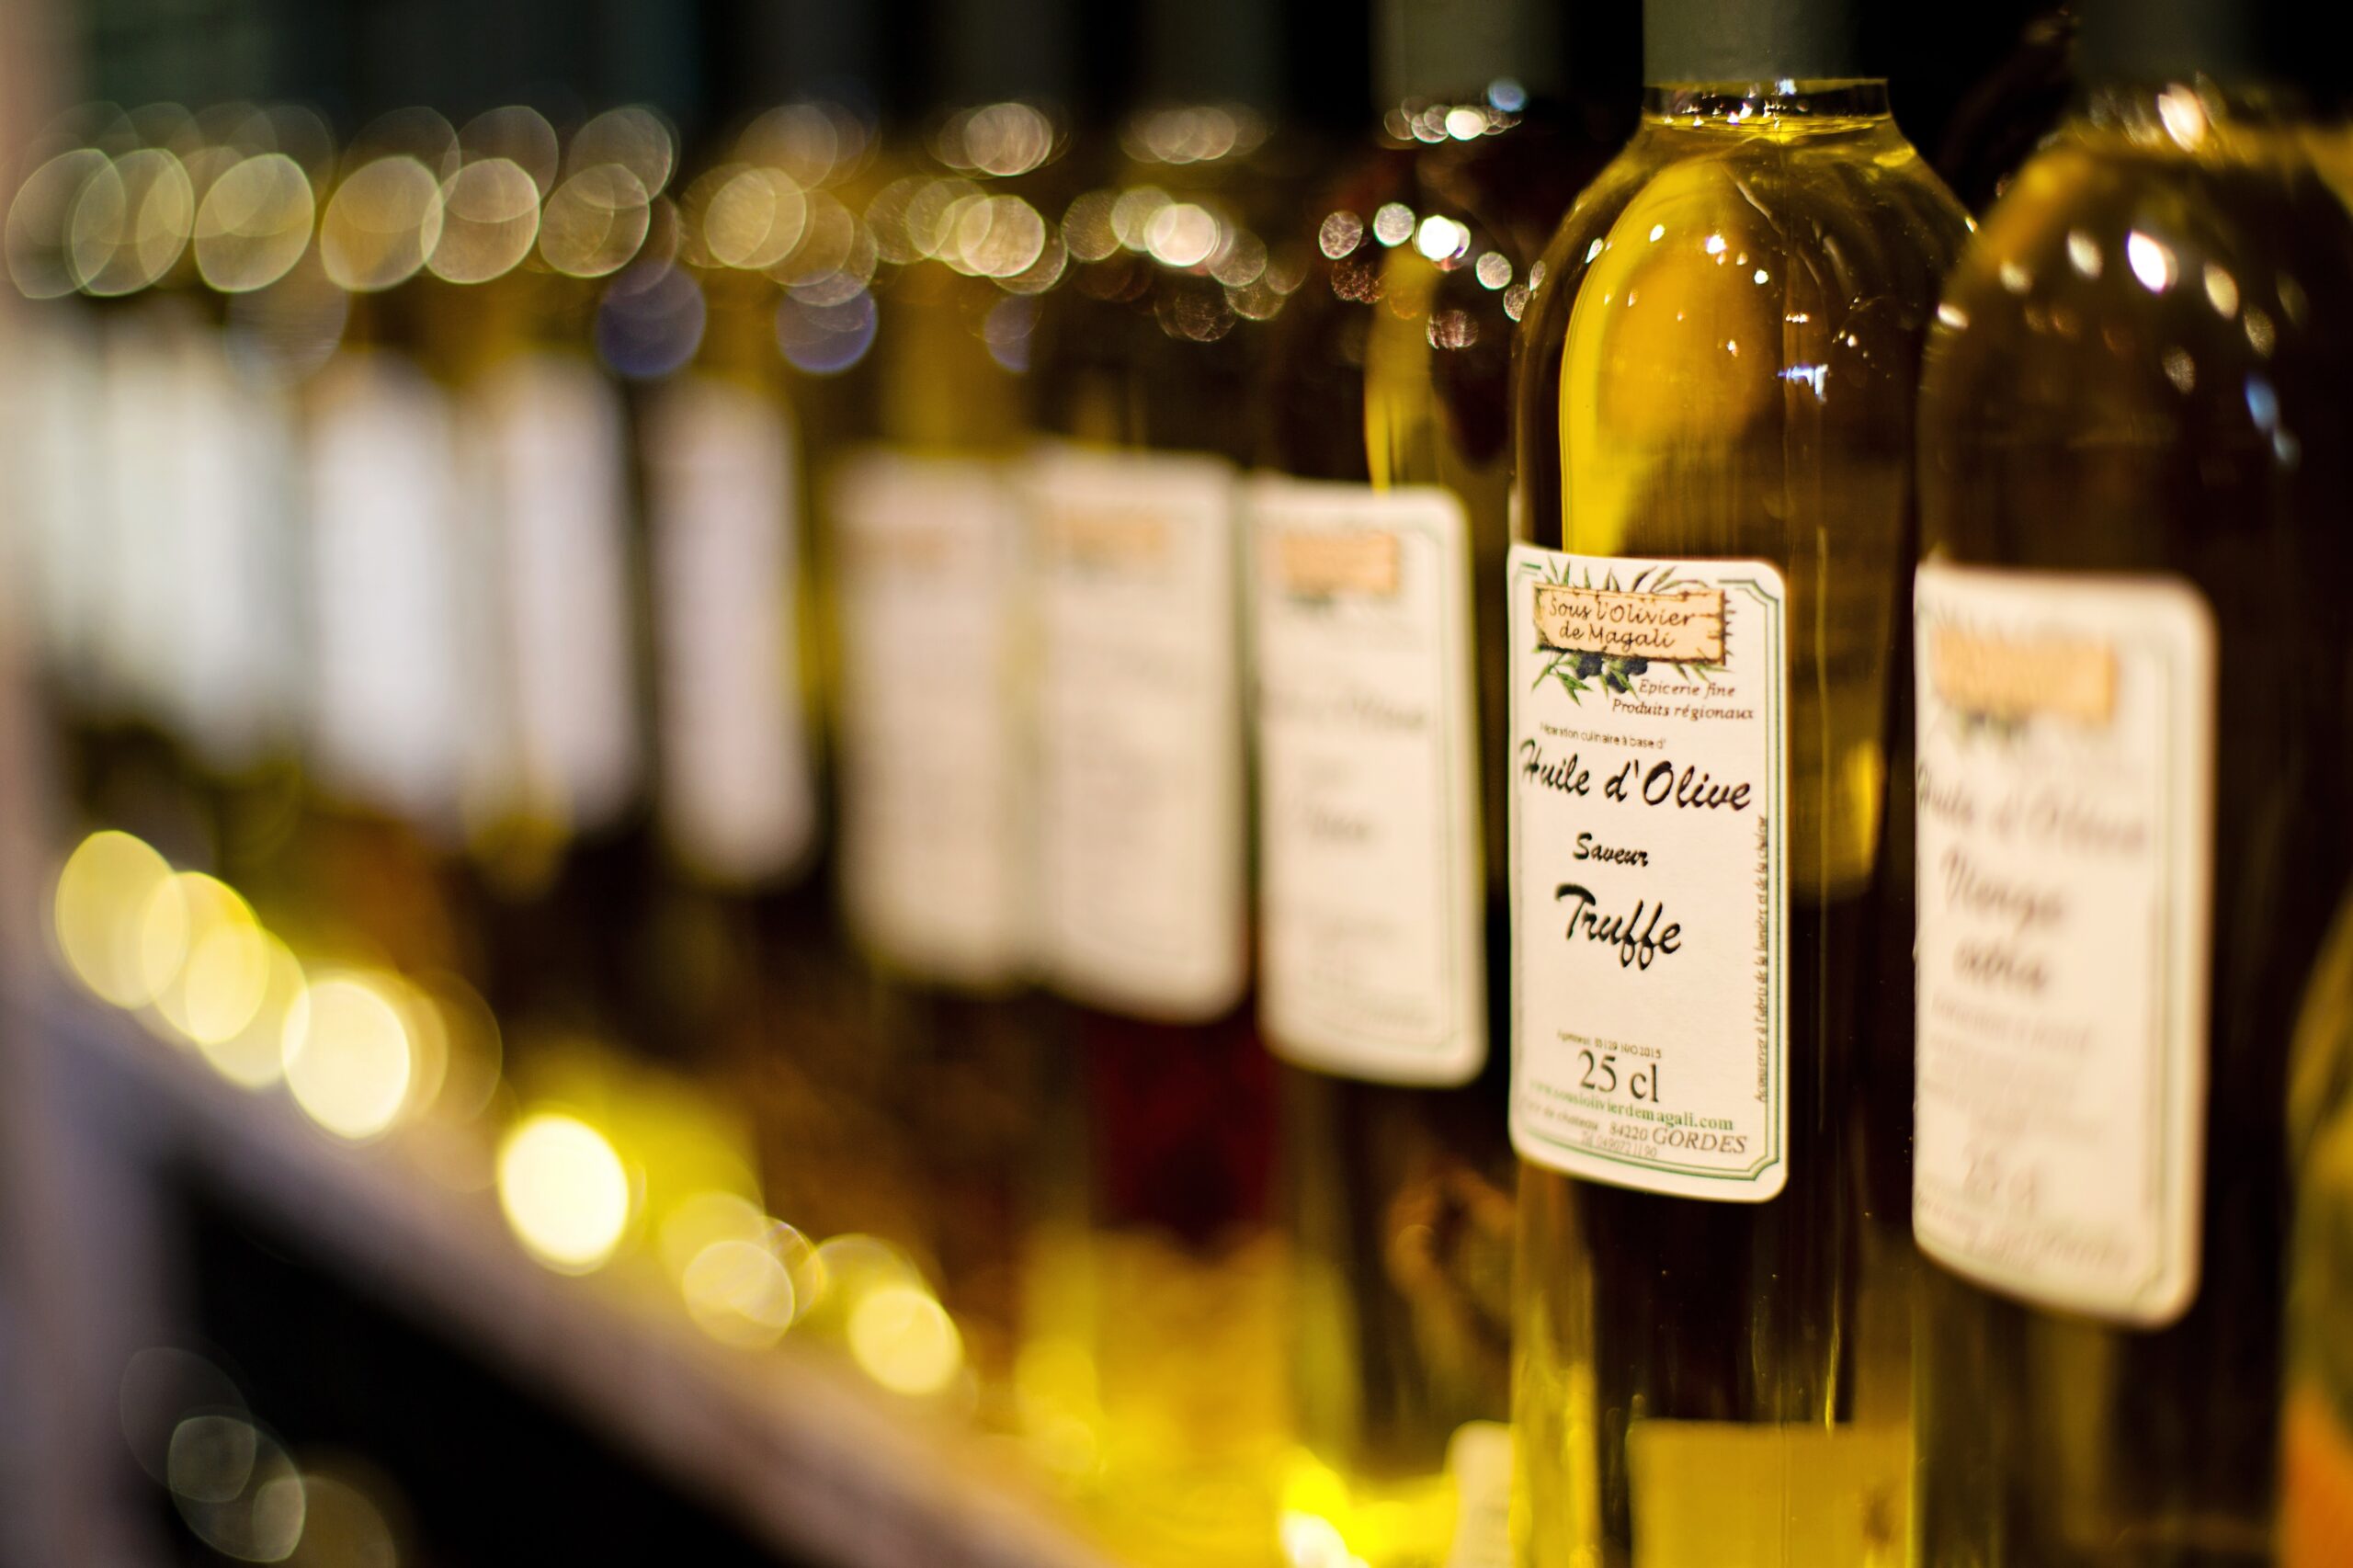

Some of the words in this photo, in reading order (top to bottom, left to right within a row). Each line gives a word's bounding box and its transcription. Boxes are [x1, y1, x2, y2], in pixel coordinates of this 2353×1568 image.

[1550, 597, 1591, 619] Sous
[1597, 602, 1692, 627] l'Olivier
[1559, 621, 1585, 641] de
[1588, 624, 1676, 652] Magali
[1640, 679, 1699, 700] Epicerie
[1704, 682, 1736, 700] fine
[1612, 699, 1669, 716] Produits
[1673, 705, 1755, 722] régionaux
[1580, 731, 1620, 746] culinaire
[1630, 736, 1654, 749] base
[1519, 738, 1591, 798] Huile
[1604, 758, 1752, 812] d'Olive
[1573, 831, 1650, 868] Saveur
[1554, 881, 1682, 971] Truffe
[1577, 1049, 1618, 1094] 25
[1629, 1062, 1660, 1104] cl
[1608, 1121, 1650, 1142] 84220
[1652, 1128, 1749, 1155] GORDES
